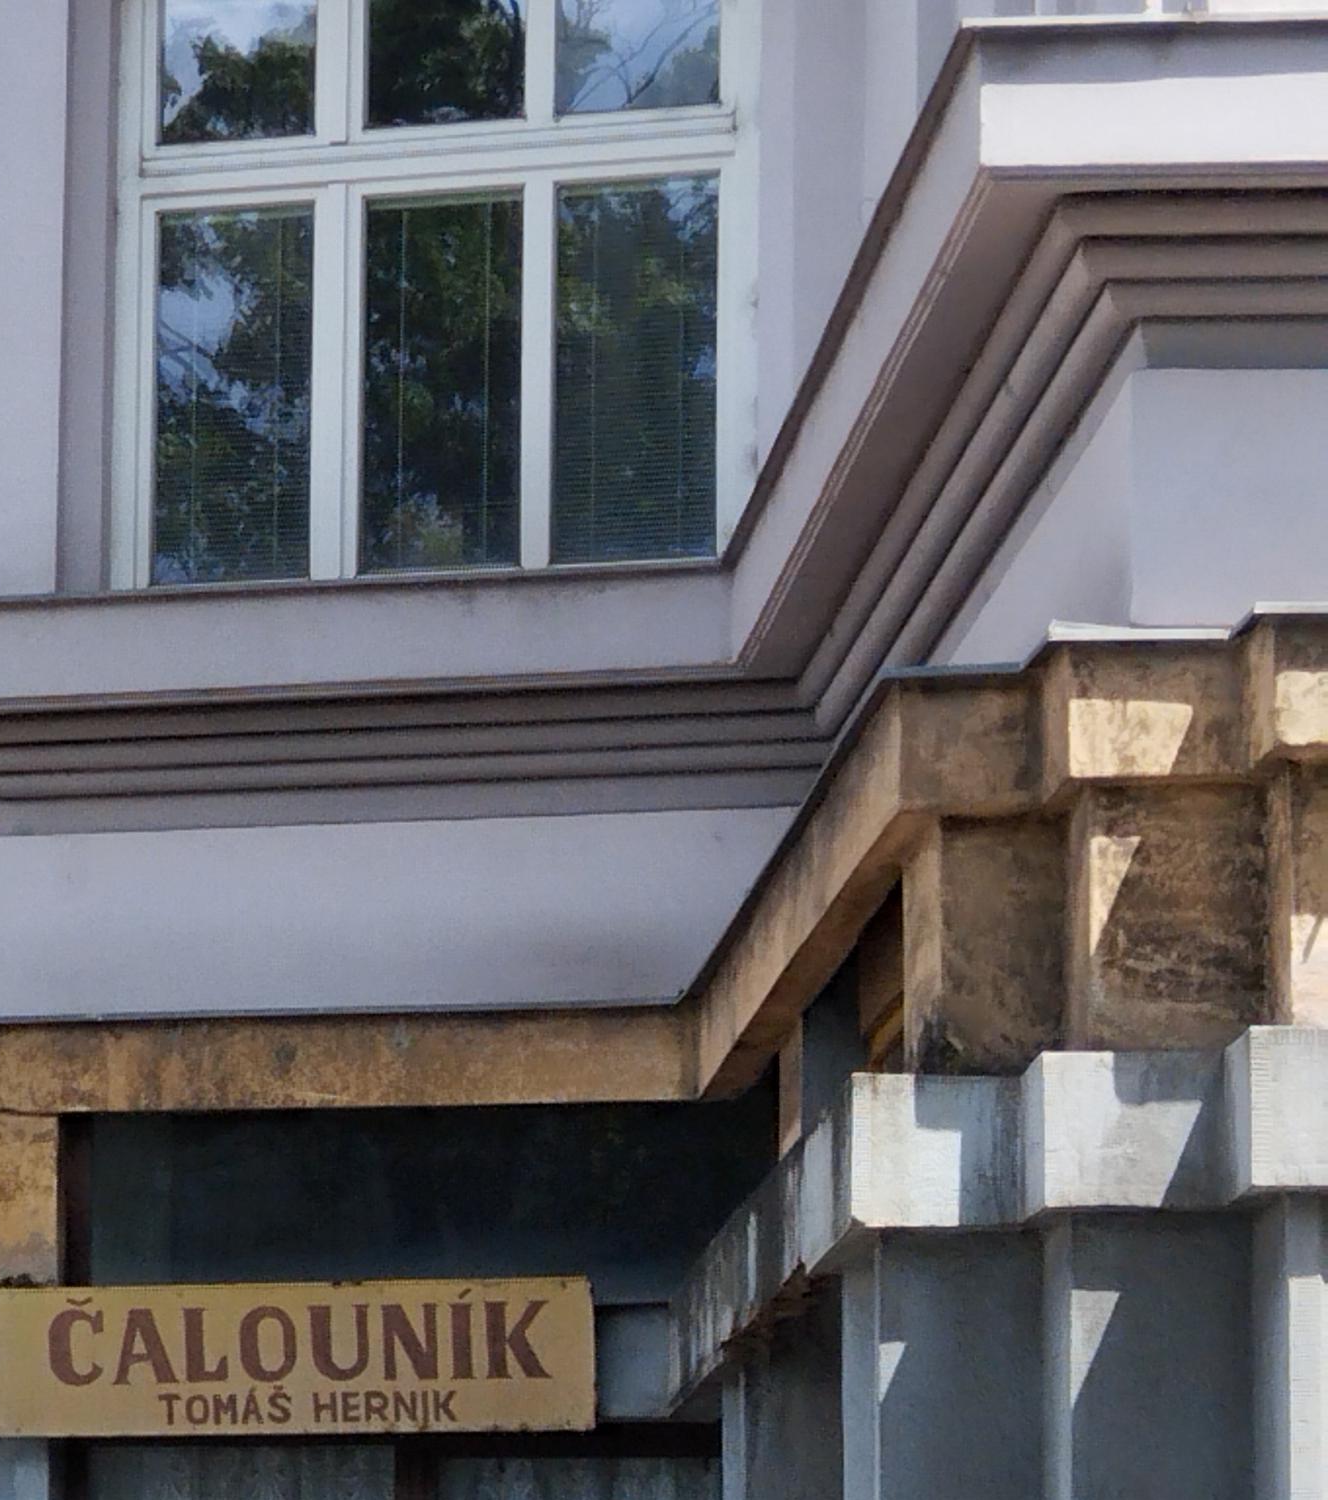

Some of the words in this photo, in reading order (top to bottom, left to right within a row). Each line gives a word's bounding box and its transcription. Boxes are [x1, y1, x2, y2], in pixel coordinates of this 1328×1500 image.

[48, 1288, 552, 1386] ČALOUNÍK
[158, 1385, 292, 1425] TOMÁŠ
[312, 1389, 458, 1424] HERNIK
